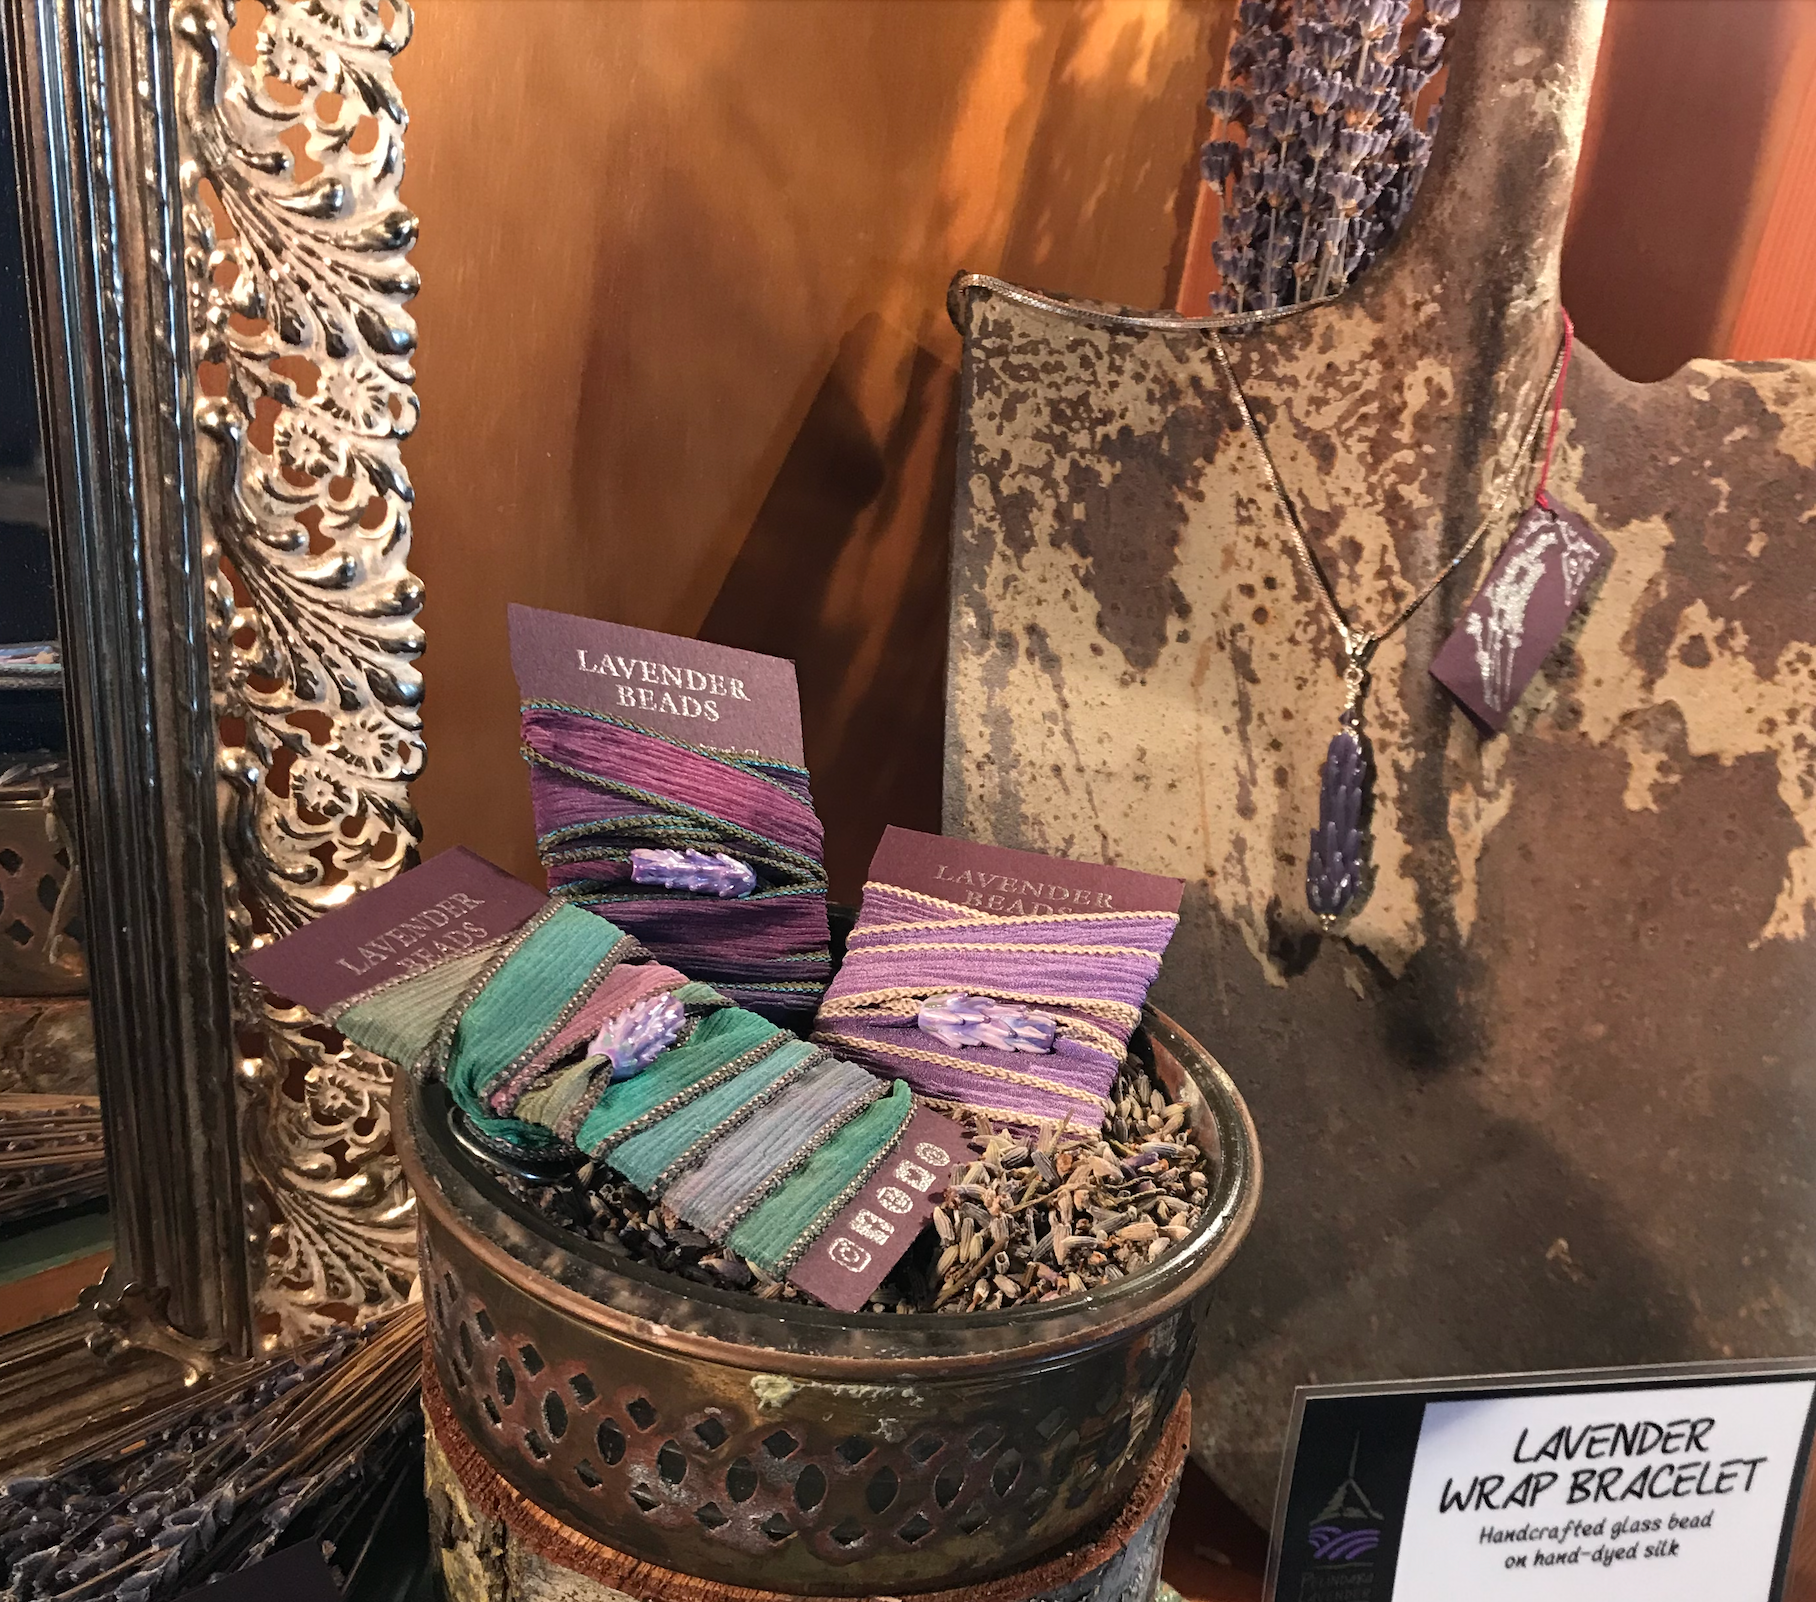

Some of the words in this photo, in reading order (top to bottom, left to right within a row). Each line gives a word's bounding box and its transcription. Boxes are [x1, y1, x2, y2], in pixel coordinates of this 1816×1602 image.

[576, 649, 751, 701] LAVENDER
[615, 684, 720, 722] BEADS
[933, 864, 1115, 910] LAVENDER
[335, 892, 486, 976] LAVENDER
[1513, 1417, 1715, 1464] LAVENDER
[1439, 1472, 1559, 1513] WRAP
[1566, 1456, 1768, 1505] BRACELET
[1479, 1518, 1606, 1545] Handcrafted
[1610, 1515, 1662, 1540] glass
[1667, 1509, 1714, 1531] bead
[1504, 1553, 1527, 1570] on
[1533, 1540, 1638, 1568] hand-dyed
[1643, 1539, 1680, 1558] silk
